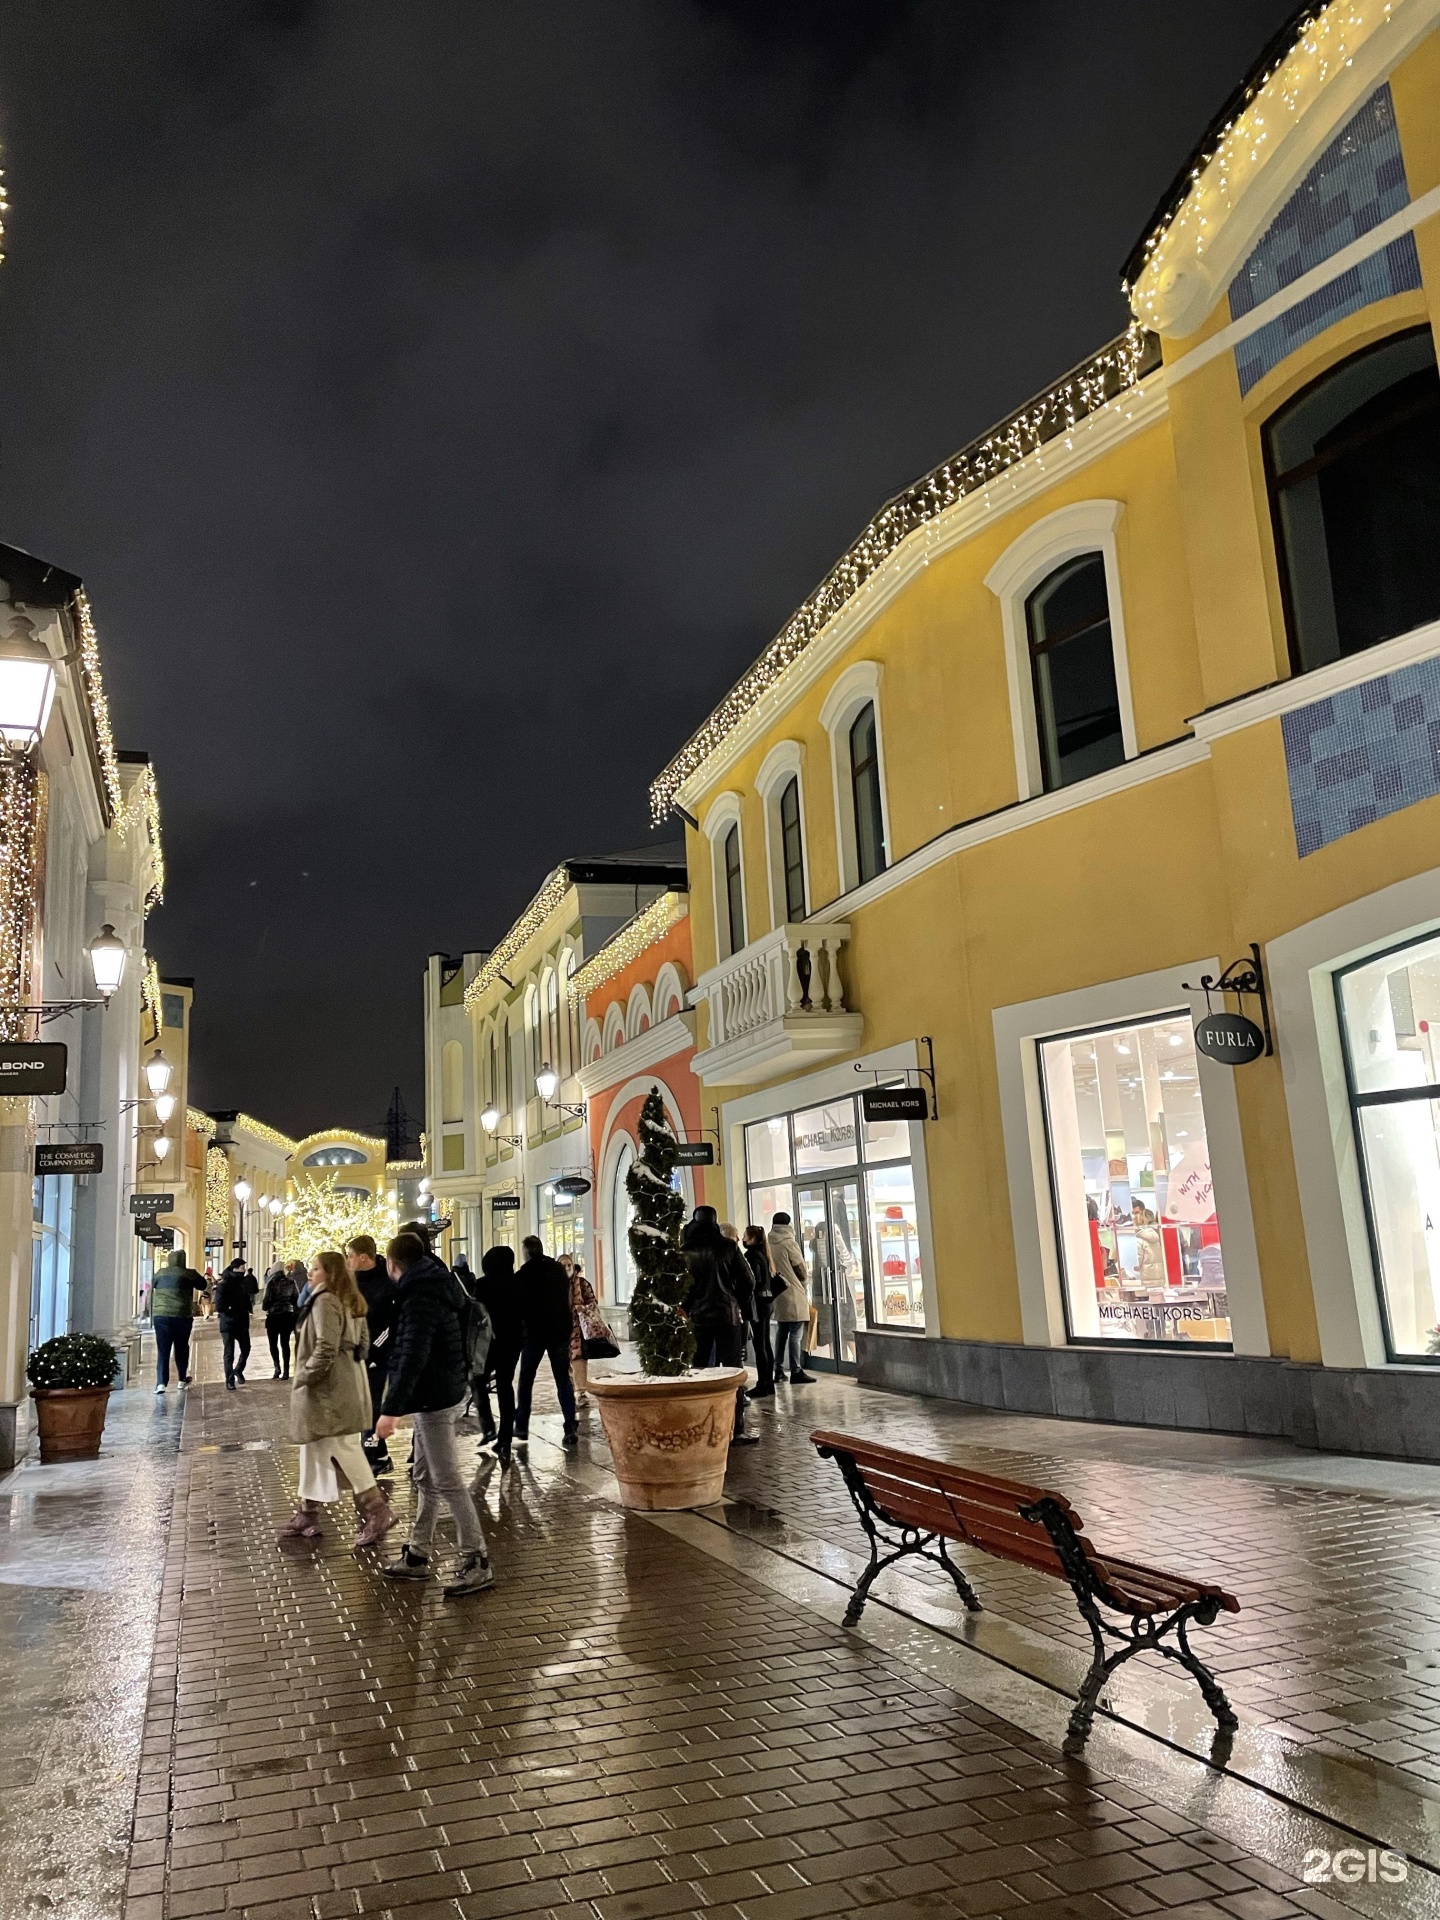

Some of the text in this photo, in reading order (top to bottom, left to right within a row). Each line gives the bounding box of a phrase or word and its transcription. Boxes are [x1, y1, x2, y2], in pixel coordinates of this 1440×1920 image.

[1206, 1031, 1255, 1046] FURLA
[0, 1062, 45, 1070] BOND
[869, 1101, 899, 1109] MICHAEL
[54, 1152, 95, 1160] COSMETICS
[1178, 1170, 1200, 1195] WITH
[1099, 1306, 1203, 1321] MICHAEL KORS
